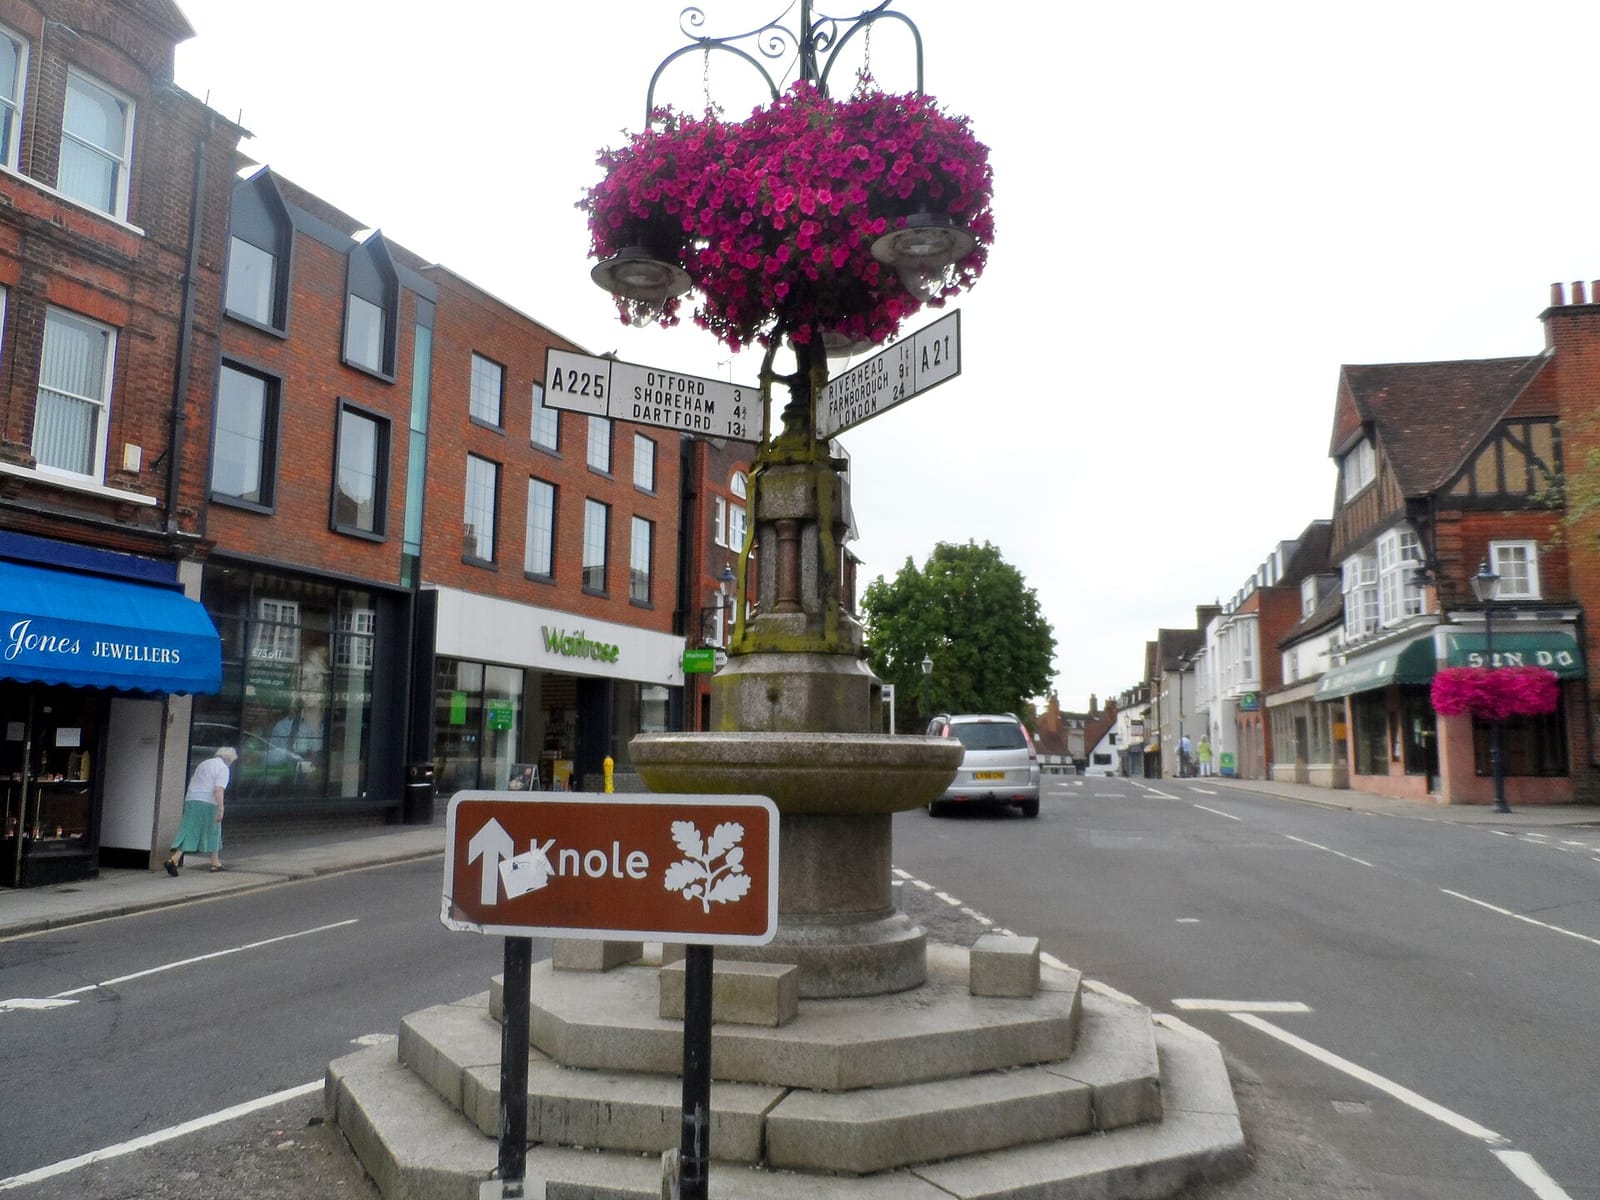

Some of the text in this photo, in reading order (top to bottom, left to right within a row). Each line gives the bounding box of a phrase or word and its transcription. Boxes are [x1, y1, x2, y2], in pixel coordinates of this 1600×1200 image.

[921, 334, 950, 374] A21
[551, 367, 605, 399] A225
[647, 372, 742, 403] OTFORD 3
[828, 357, 884, 401] RIVERHEAD
[828, 371, 890, 417] FARNBOROUGH
[632, 403, 712, 431] DARTFORD
[634, 385, 716, 415] SHOREHAM
[838, 381, 905, 428] LONDON 24
[4, 619, 181, 664] Jones JEWELLERS
[541, 624, 620, 665] Waitrose
[529, 837, 650, 880] Knole
